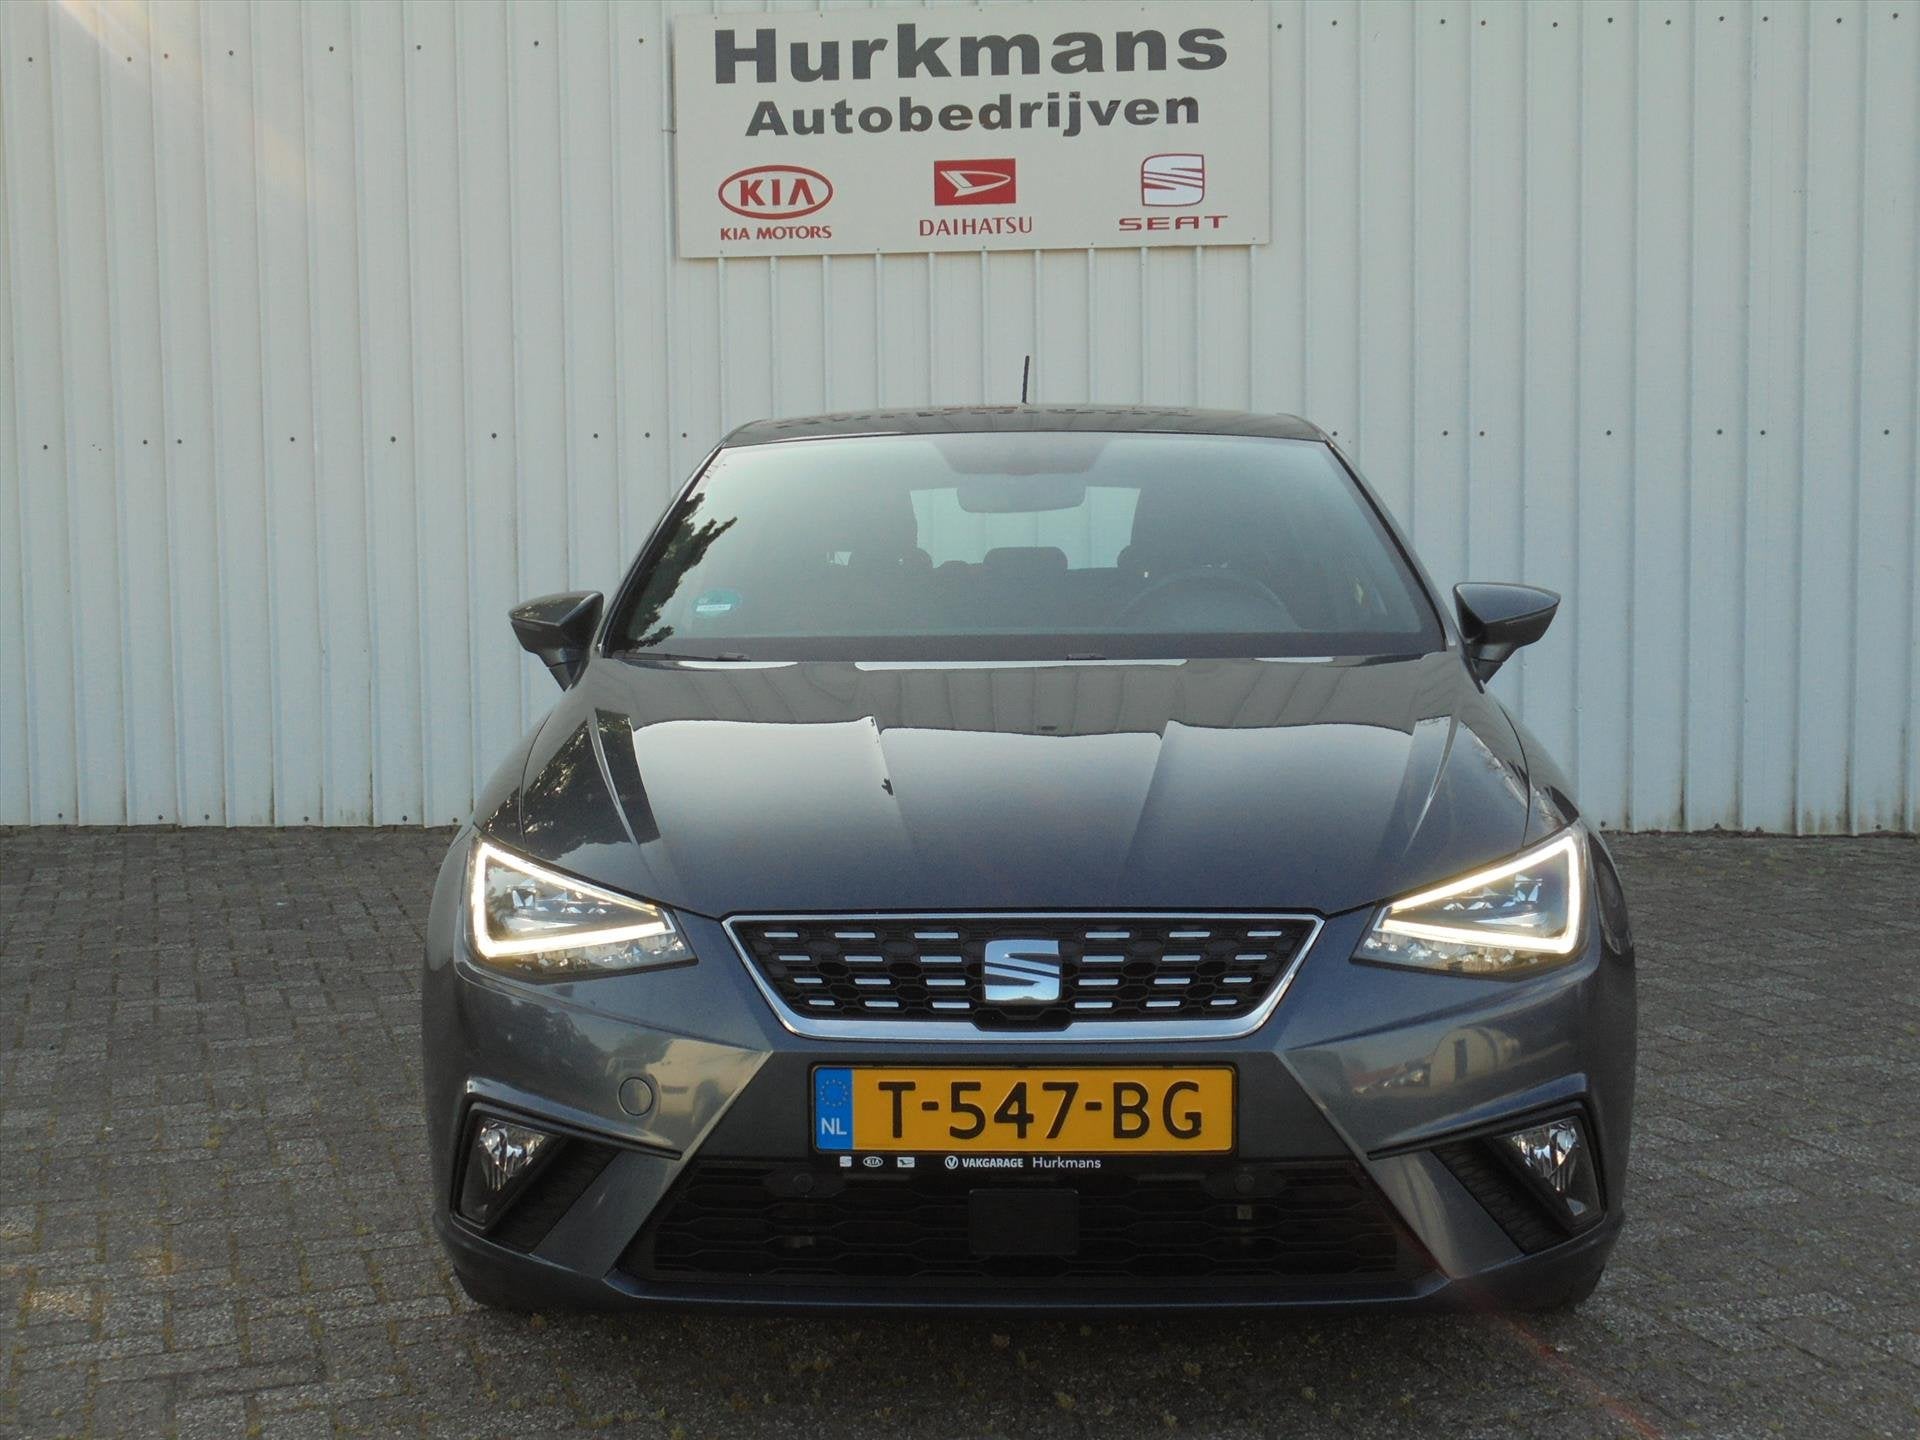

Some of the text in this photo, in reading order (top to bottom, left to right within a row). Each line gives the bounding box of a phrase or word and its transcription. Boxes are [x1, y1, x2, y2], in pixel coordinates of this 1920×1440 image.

[714, 23, 1228, 84] Hurkmans
[745, 91, 1199, 137] Autobedrijven
[740, 178, 815, 206] KIA
[720, 225, 832, 240] KIA MOTORS
[919, 216, 1033, 237] DAIHATSU
[1119, 215, 1228, 231] SEAT
[878, 1081, 1202, 1139] T-547-BG
[821, 1118, 847, 1136] NL
[962, 1158, 1024, 1168] VAKGARAGE
[1032, 1156, 1101, 1168] Hurkmans
